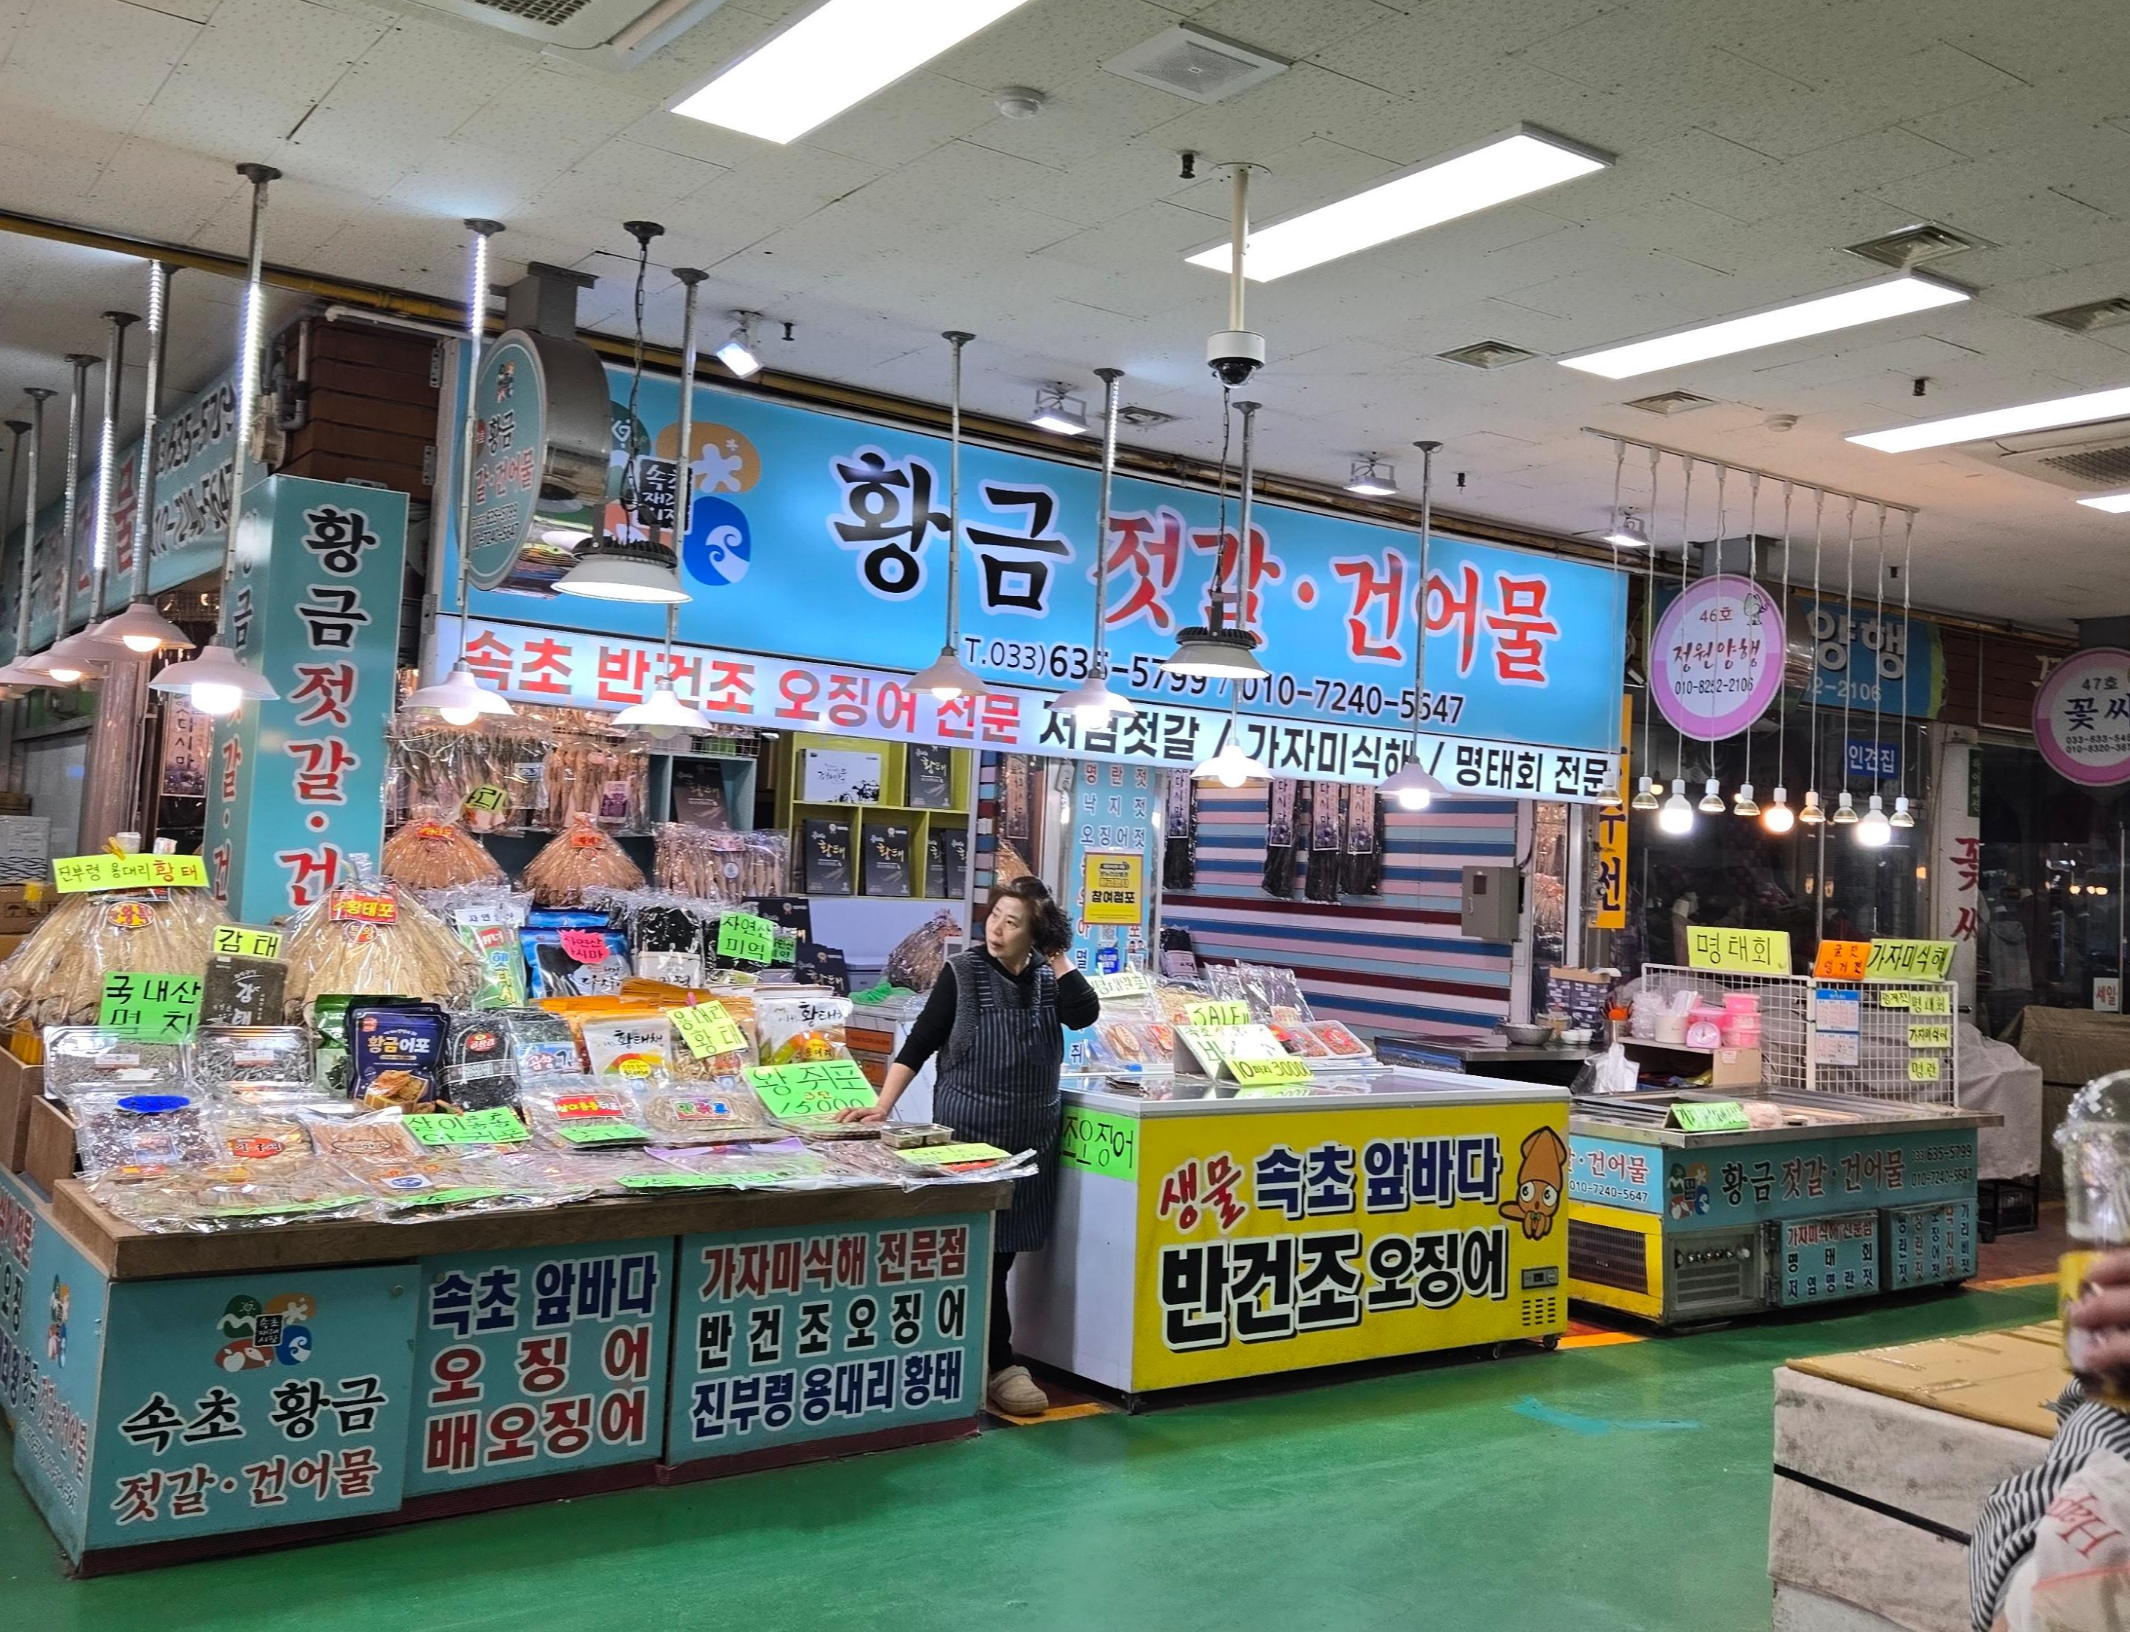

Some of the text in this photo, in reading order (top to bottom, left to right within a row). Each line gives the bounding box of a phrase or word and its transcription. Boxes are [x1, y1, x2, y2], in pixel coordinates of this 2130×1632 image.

[488, 409, 516, 457] 황금
[475, 446, 534, 506] 갈·건어물
[299, 508, 377, 648] 황금
[835, 449, 1558, 684] 황금 젓갈·건어물
[1699, 606, 1734, 623] 46호
[1671, 637, 1762, 674] 정원양행
[1806, 609, 1906, 680] 양행
[1242, 674, 1464, 723] 010-7240-5647
[2082, 676, 2119, 692] 47호
[465, 629, 573, 695] 속초
[598, 645, 756, 717] 반건조
[774, 667, 916, 733] 오징어
[936, 693, 1021, 745] 전문
[1246, 723, 1418, 781] 가자미식해
[1455, 744, 1543, 793] 명태회
[1554, 755, 1611, 797] 전문
[1085, 763, 1149, 788] 명란젓
[1848, 745, 1896, 774] 인견집
[1084, 794, 1148, 818] 낙지젓
[1080, 824, 1148, 850] 오징어젓
[152, 859, 199, 883] 황태
[218, 928, 279, 958] 감태
[720, 913, 773, 942] 자연산
[725, 936, 766, 961] 미역
[1696, 934, 1773, 966] 명태회
[105, 975, 201, 1004] 국내산
[367, 1035, 431, 1054] 황금어포
[690, 1026, 743, 1055] 황태
[1159, 1134, 1503, 1231] 생물 속초 앞바다
[1569, 1180, 1649, 1202] 010-7240-5647
[1721, 1161, 1776, 1206] 황금
[1781, 1149, 1907, 1200] 젓갈·건어물
[700, 1226, 968, 1300] 가자미식해 전문점
[1787, 1241, 1874, 1273] 명태회
[431, 1254, 657, 1336] 속초 앞바다
[1161, 1226, 1507, 1352] 반건조 오징어
[692, 1349, 964, 1440] 진부령 용대리 황태
[122, 1376, 387, 1454] 속초 황금
[425, 1391, 647, 1473] 배오징어
[115, 1449, 379, 1525] 젓갈·건어물
